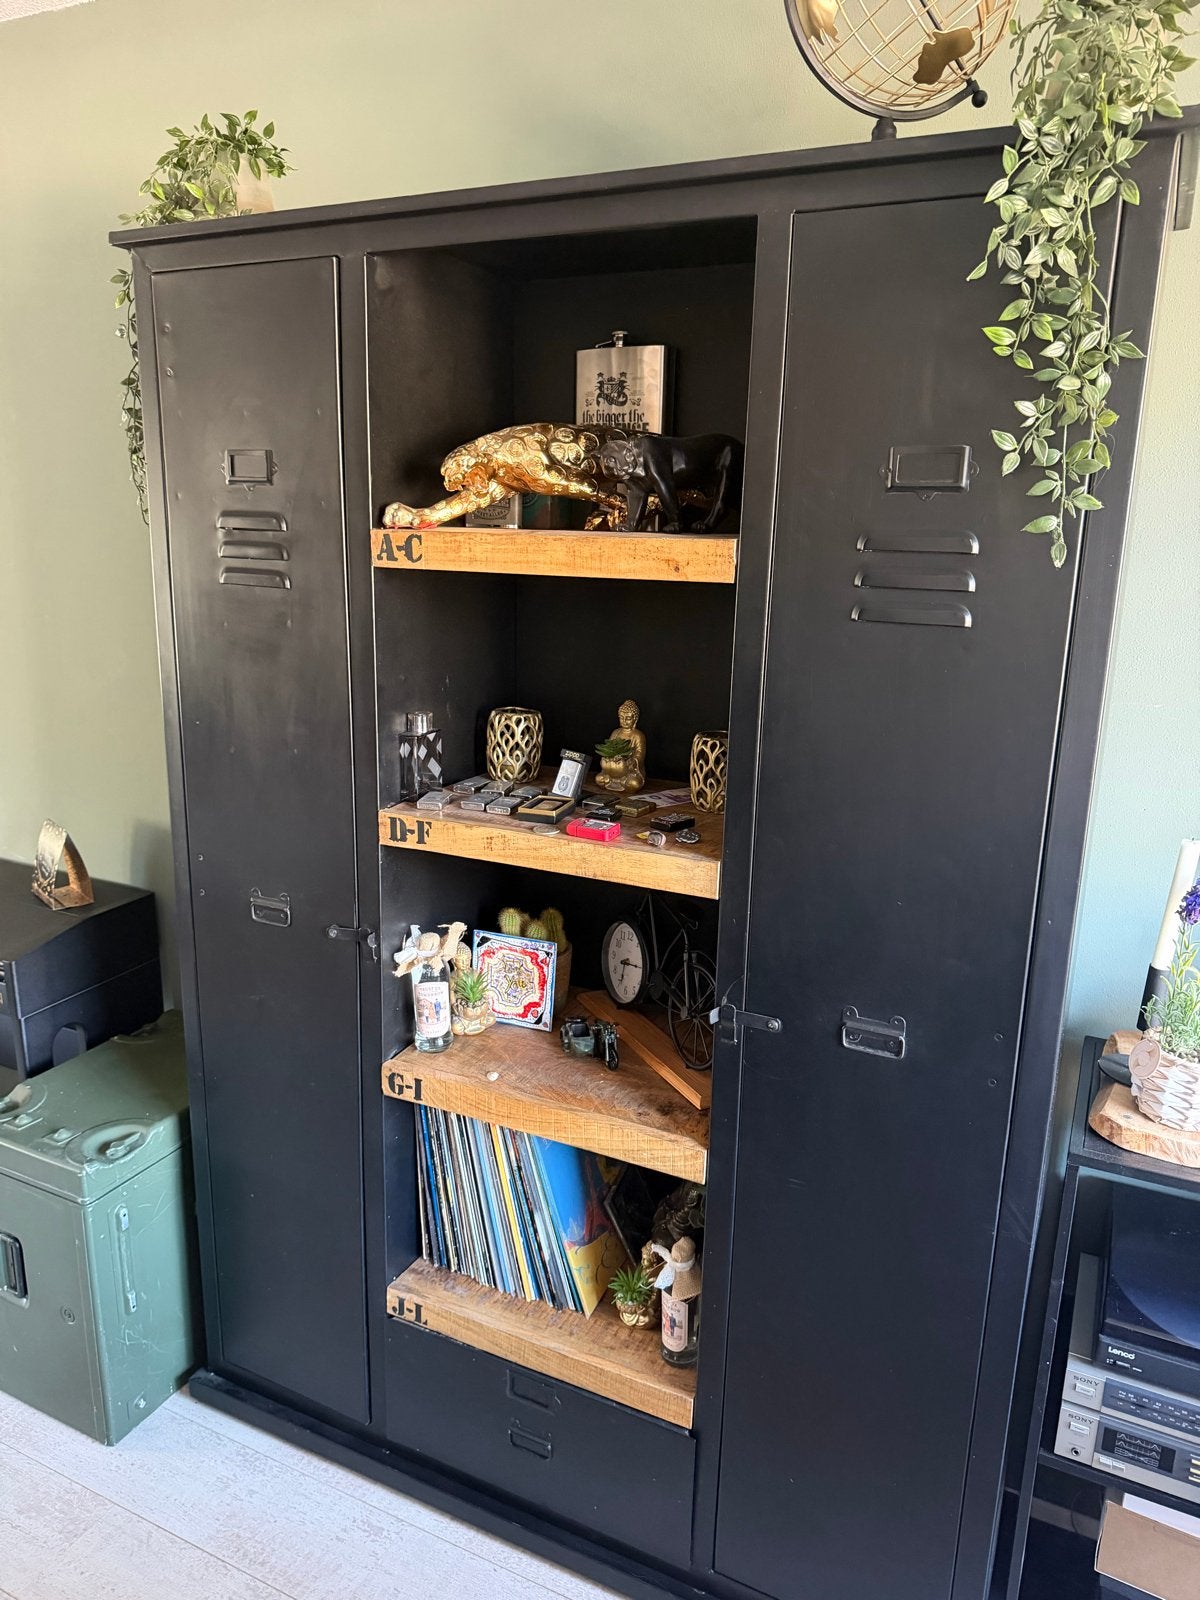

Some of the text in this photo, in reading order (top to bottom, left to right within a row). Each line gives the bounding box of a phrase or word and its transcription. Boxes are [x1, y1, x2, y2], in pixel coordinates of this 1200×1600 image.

[582, 408, 645, 425] the bigger the
[376, 533, 423, 563] A-C
[388, 816, 432, 844] D-F
[620, 930, 626, 941] 11
[627, 930, 634, 942] 12
[611, 950, 617, 960] 9
[623, 986, 628, 996] 6
[388, 1072, 423, 1101] G-I
[392, 1296, 428, 1325] J-L
[1108, 1346, 1136, 1360] Lenco
[1073, 1375, 1100, 1386] SONY
[1067, 1413, 1094, 1425] SONY
